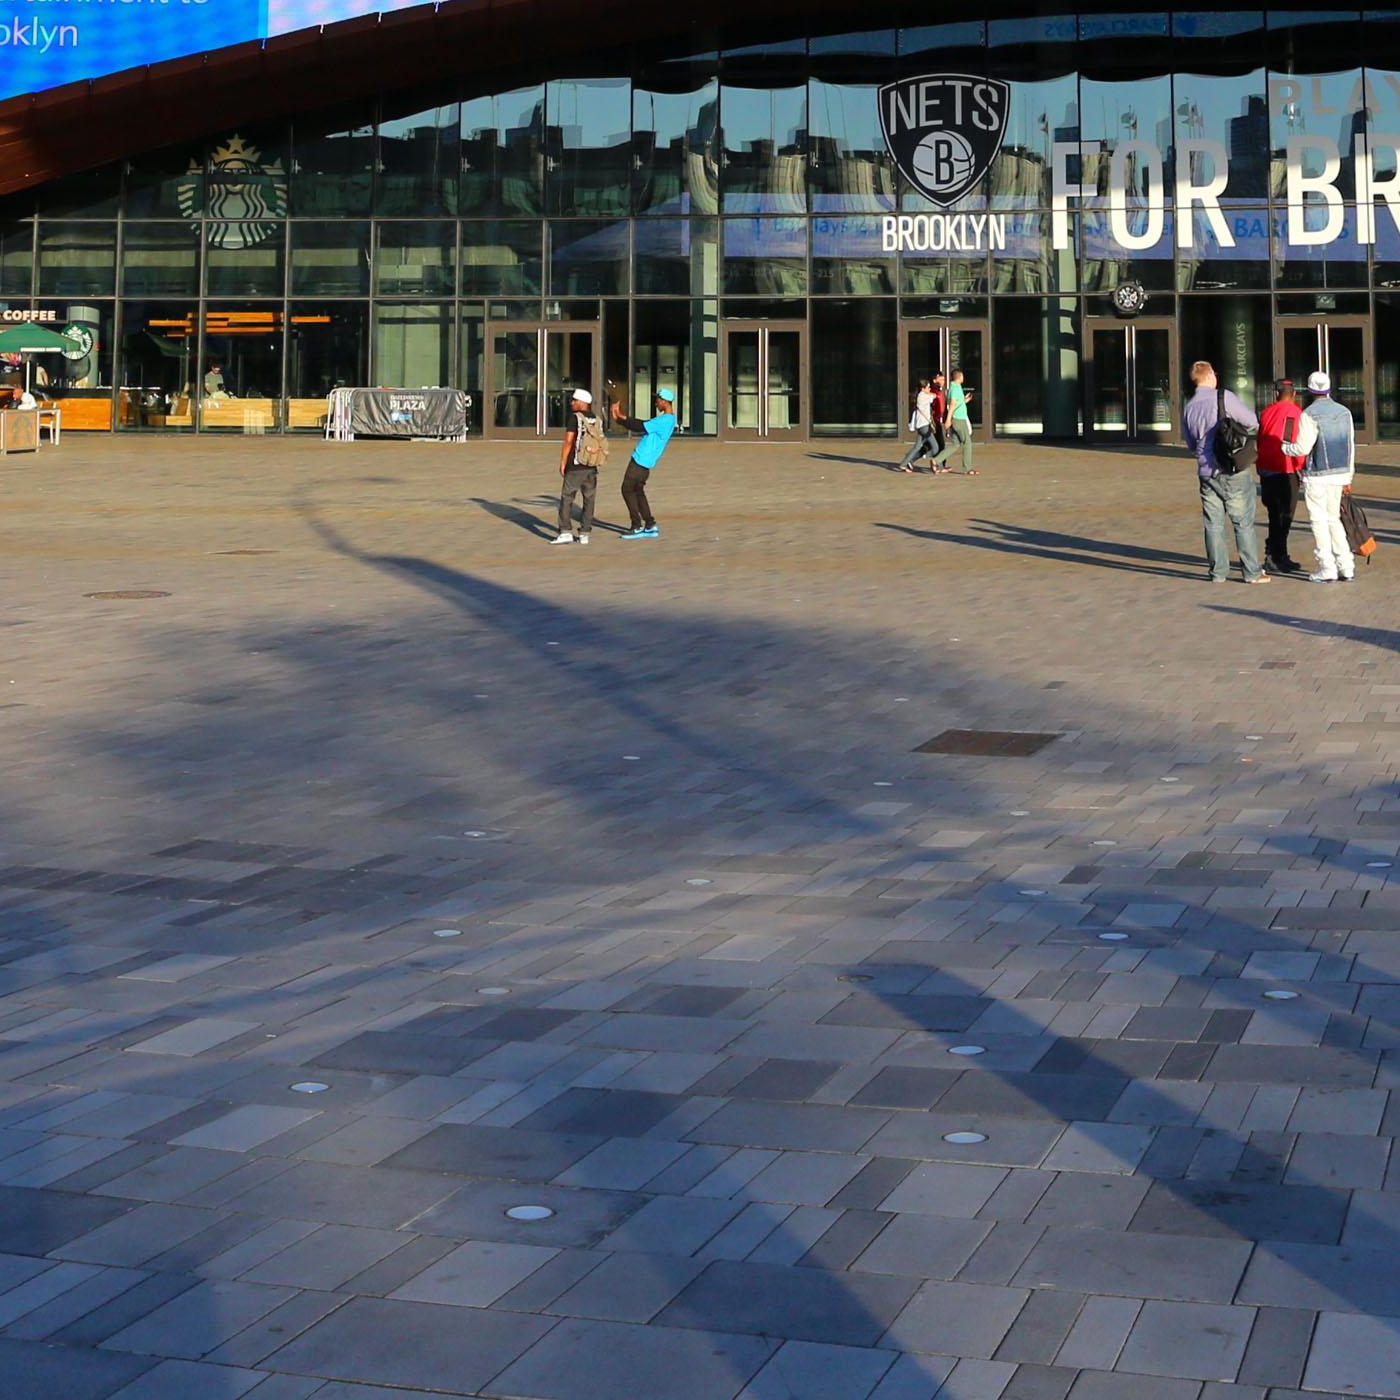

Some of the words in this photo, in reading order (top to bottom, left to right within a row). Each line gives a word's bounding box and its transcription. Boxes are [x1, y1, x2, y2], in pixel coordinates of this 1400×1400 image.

[889, 80, 1000, 136] NETS
[935, 139, 955, 185] B
[1053, 137, 1237, 251] FOR
[882, 214, 1006, 251] BROOKLYN
[3, 310, 56, 320] COFFEE
[1236, 321, 1247, 375] BARCLAYS
[390, 400, 426, 411] PLAZA
